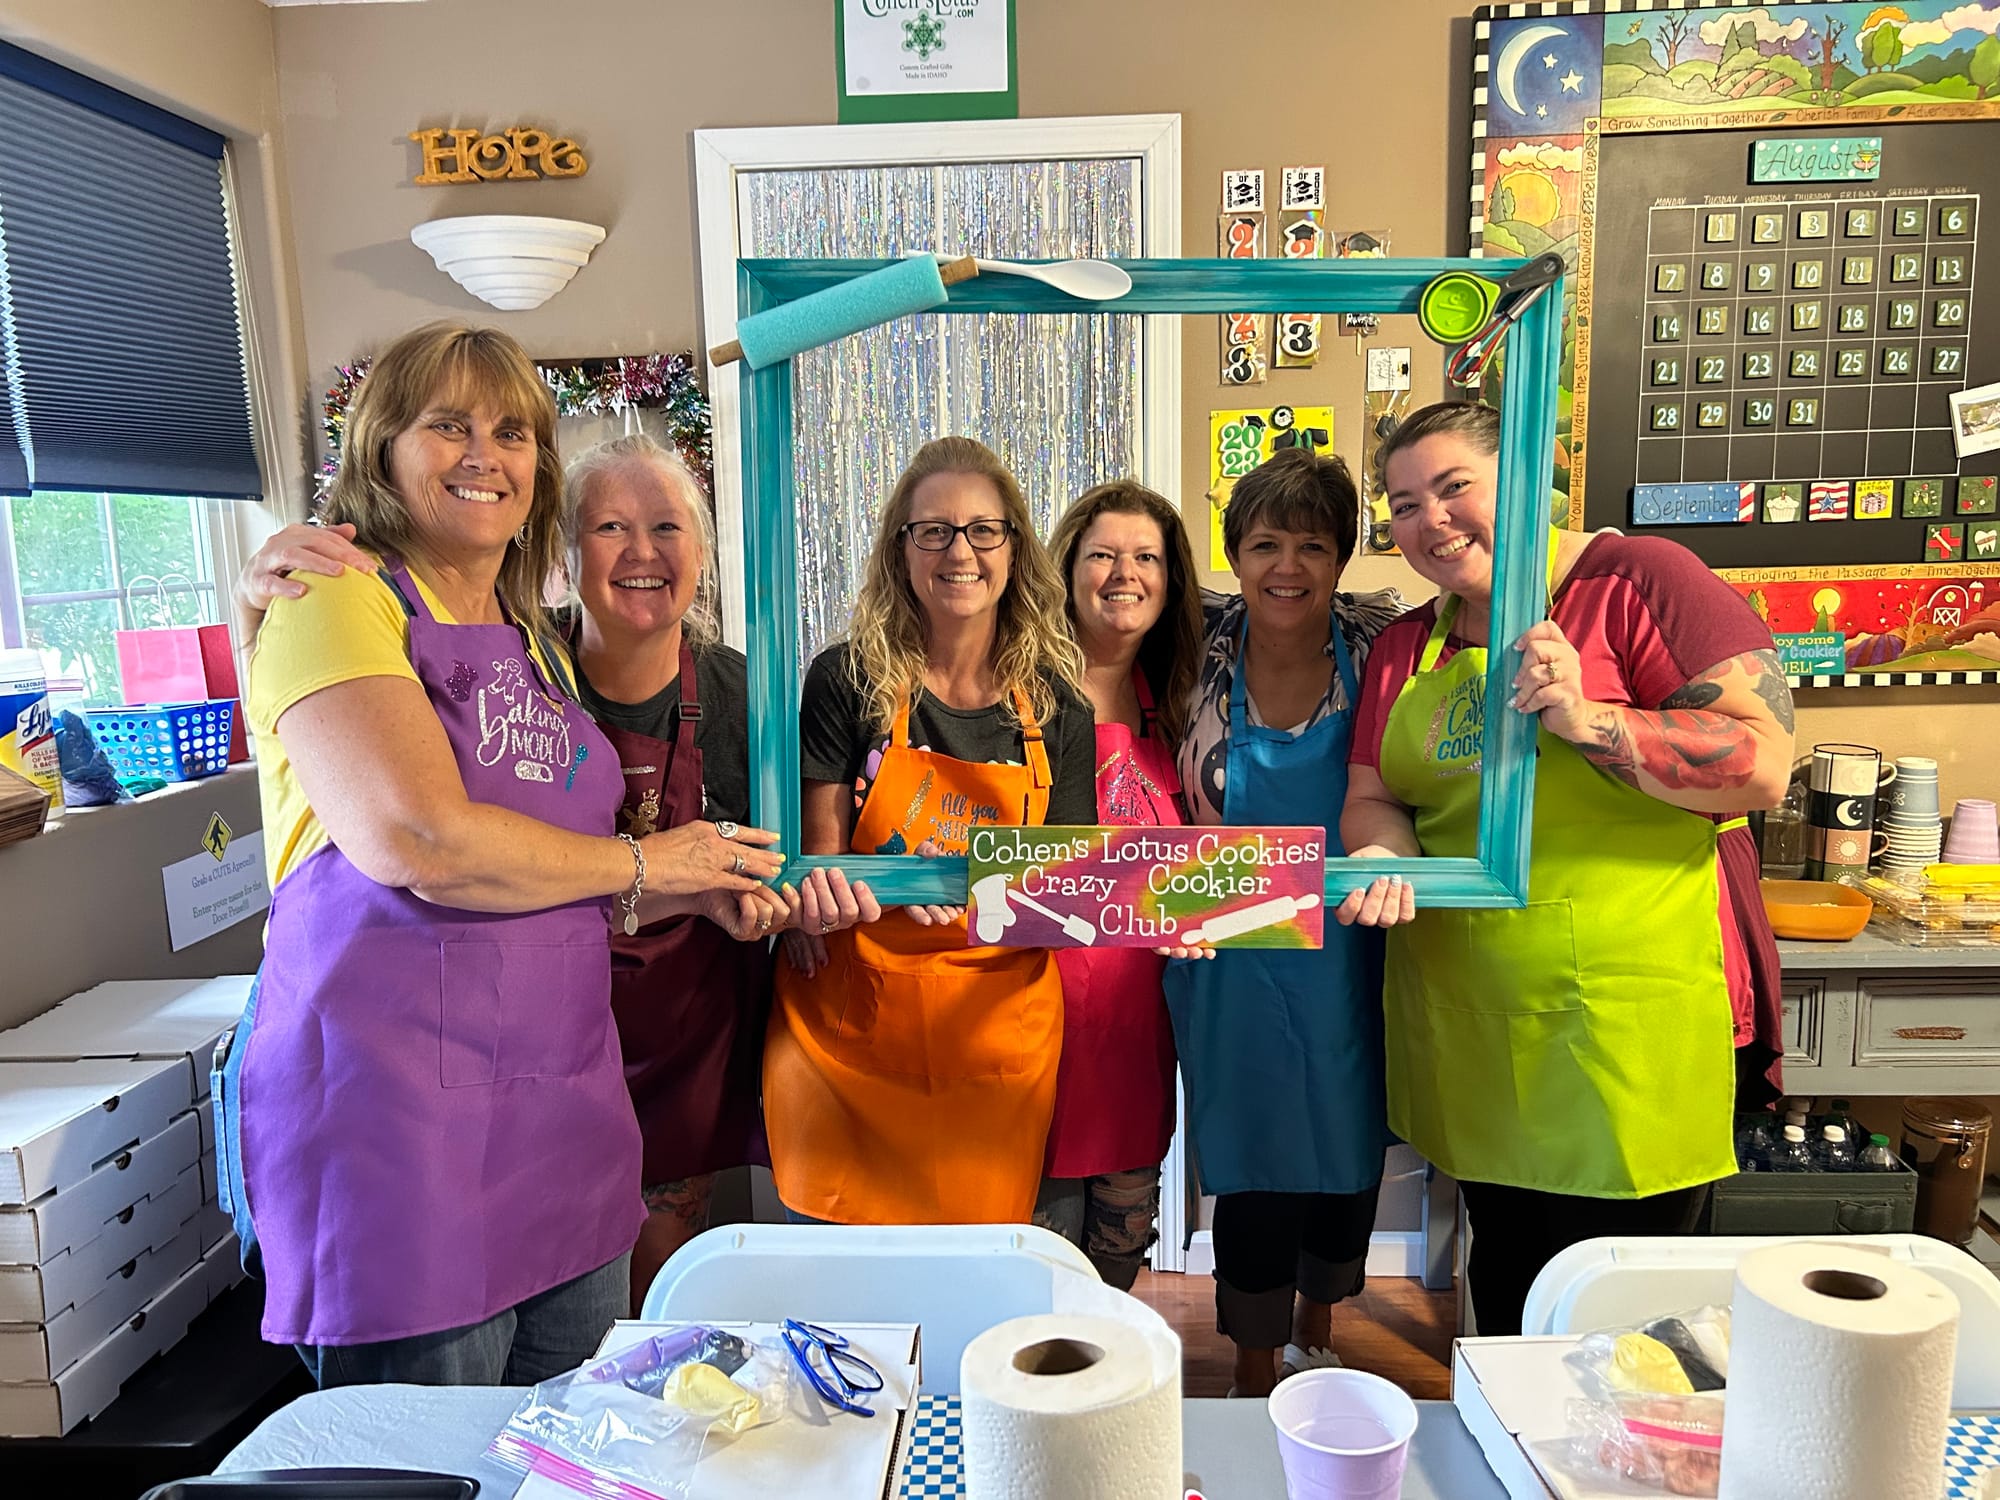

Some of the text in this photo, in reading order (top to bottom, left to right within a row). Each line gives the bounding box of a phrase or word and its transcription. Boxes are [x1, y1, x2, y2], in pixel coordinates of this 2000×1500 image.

[1608, 105, 1882, 131] Grow Something Together Cherish Family
[1761, 144, 1855, 178] August
[1298, 172, 1308, 180] OF
[1583, 149, 1597, 197] Believe
[1655, 197, 1687, 207] MONDAY
[1704, 195, 1737, 205] TUESDAY
[1744, 193, 1787, 204] WEDNESDAY
[1840, 190, 1878, 199] FRIDAY
[1715, 217, 1725, 237] 1
[1764, 219, 1774, 238] 2
[1808, 216, 1820, 234] 3
[1852, 214, 1866, 233] 4
[1903, 211, 1916, 228] 5
[1948, 211, 1962, 229] 6
[1578, 213, 1594, 315] Seek Knowledge
[1848, 262, 1865, 281] 11
[1899, 259, 1918, 278] 12
[1941, 260, 1961, 279] 13
[1666, 270, 1677, 287] 7
[1711, 267, 1723, 286] 8
[1758, 265, 1771, 286] 9
[1800, 265, 1818, 284] 10
[1704, 311, 1721, 331] 15
[1751, 312, 1770, 332] 16
[1798, 305, 1818, 325] 17
[1844, 309, 1864, 329] 18
[1894, 304, 1914, 325] 19
[1938, 303, 1961, 323] 20
[1289, 322, 1312, 352] 3
[1660, 318, 1679, 339] 14
[1703, 359, 1725, 380] 22
[1749, 355, 1771, 376] 23
[1795, 352, 1816, 373] 24
[1841, 352, 1863, 373] 25
[1888, 351, 1907, 371] 26
[1938, 351, 1960, 371] 27
[1657, 362, 1677, 382] 21
[1574, 328, 1589, 438] Watch the Sunset
[1657, 407, 1677, 427] 28
[1702, 406, 1723, 424] 29
[1750, 402, 1772, 421] 30
[1793, 403, 1814, 422] 31
[1223, 425, 1262, 449] 20
[1225, 449, 1261, 475] 23
[1571, 453, 1583, 523] Your Heart
[1857, 484, 1891, 492] BIRTHDAY
[1641, 488, 1740, 521] September
[1741, 570, 1797, 583] Enjoying
[1809, 568, 1829, 580] the
[1837, 567, 1887, 580] Passage
[1900, 565, 1914, 576] of
[1925, 565, 1952, 577] Time
[1798, 636, 1835, 645] some
[1790, 644, 1843, 659] Cookier
[476, 688, 571, 768] baking
[511, 729, 555, 764] MODE
[941, 792, 999, 826] All you
[973, 830, 1090, 863] Cohen's
[1101, 832, 1189, 863] Lotus
[1196, 834, 1320, 868] Cookies
[192, 874, 208, 888] Grab
[212, 863, 231, 880] CUTE
[1022, 864, 1272, 902] Crazy Cookier
[193, 880, 262, 918] Enter your name for the
[1100, 904, 1178, 937] Club
